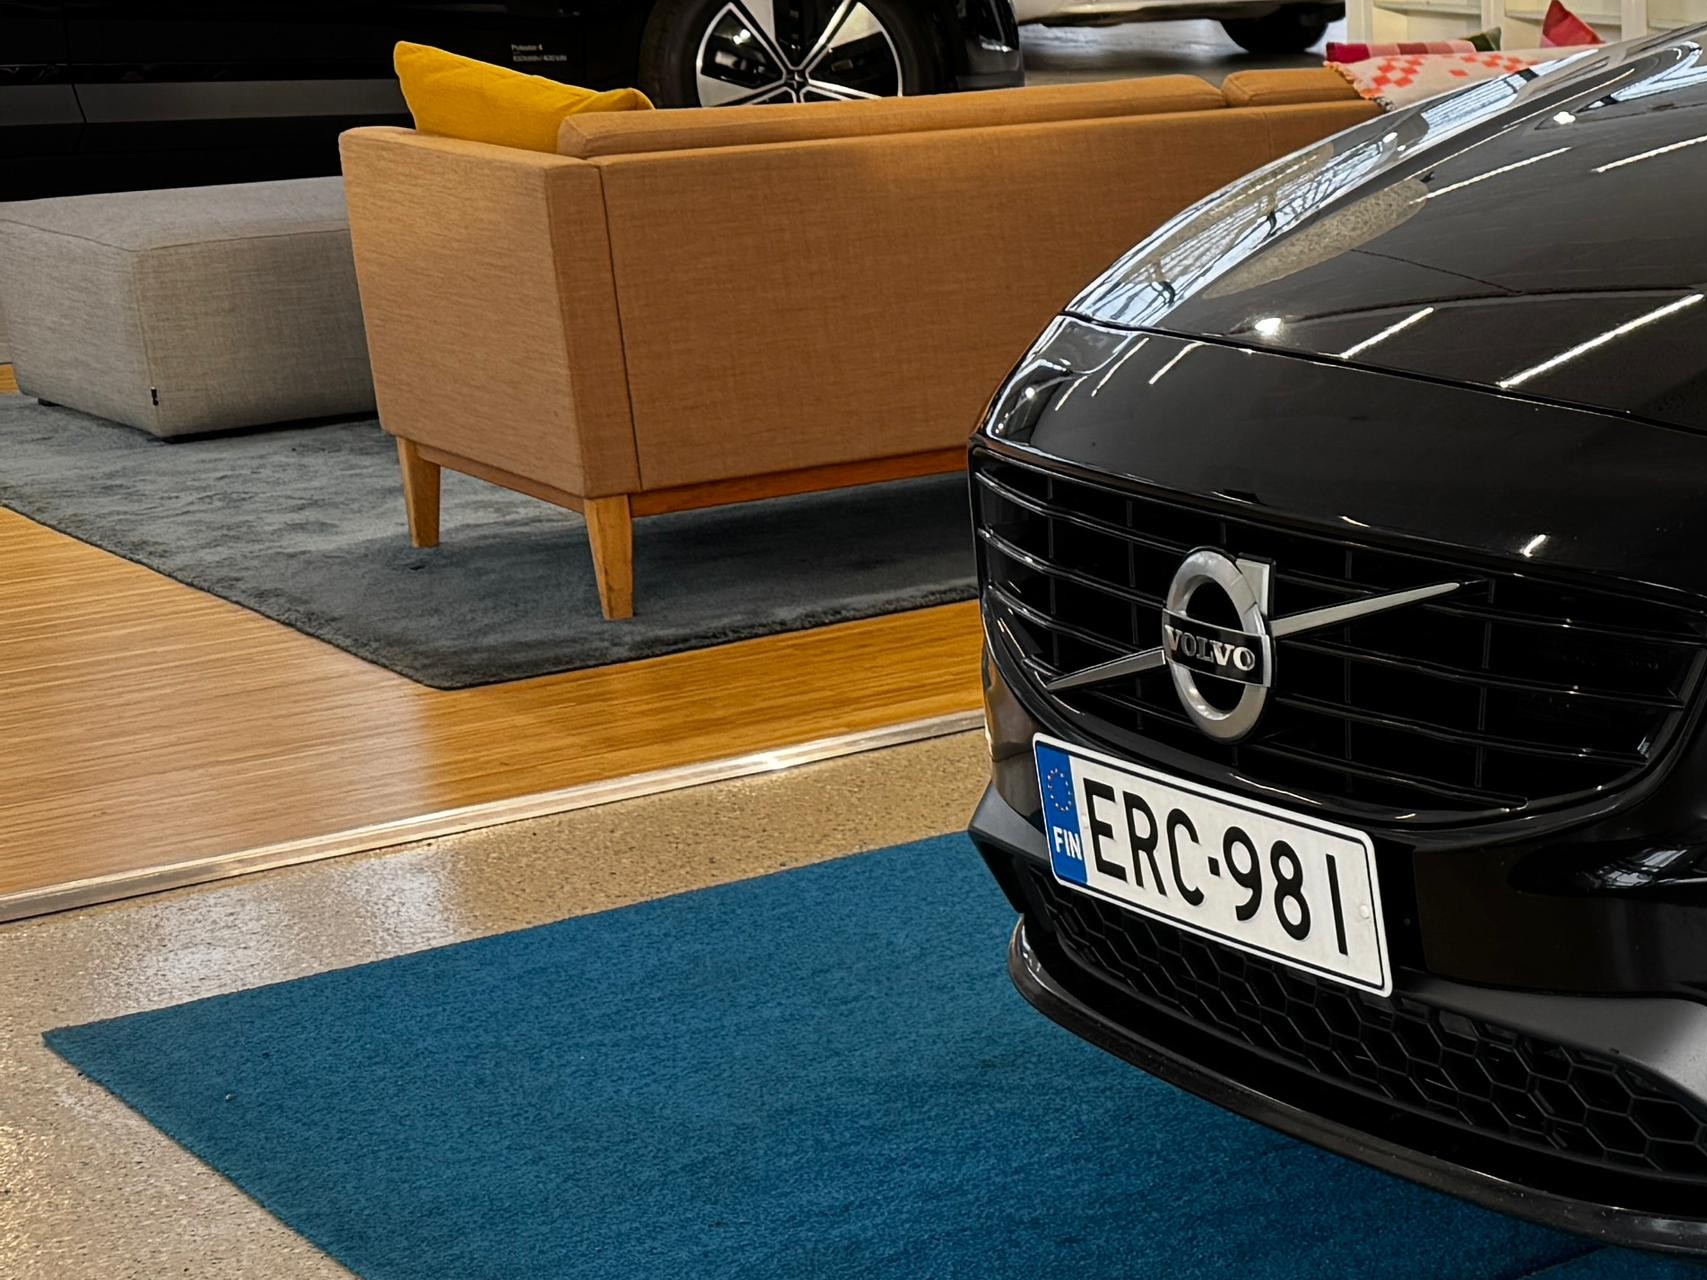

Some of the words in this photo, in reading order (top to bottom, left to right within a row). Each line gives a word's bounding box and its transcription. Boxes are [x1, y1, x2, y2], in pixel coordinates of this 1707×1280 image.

[1164, 624, 1256, 671] VOLVO
[1052, 825, 1083, 862] FIN
[1083, 777, 1349, 957] ERC-981
